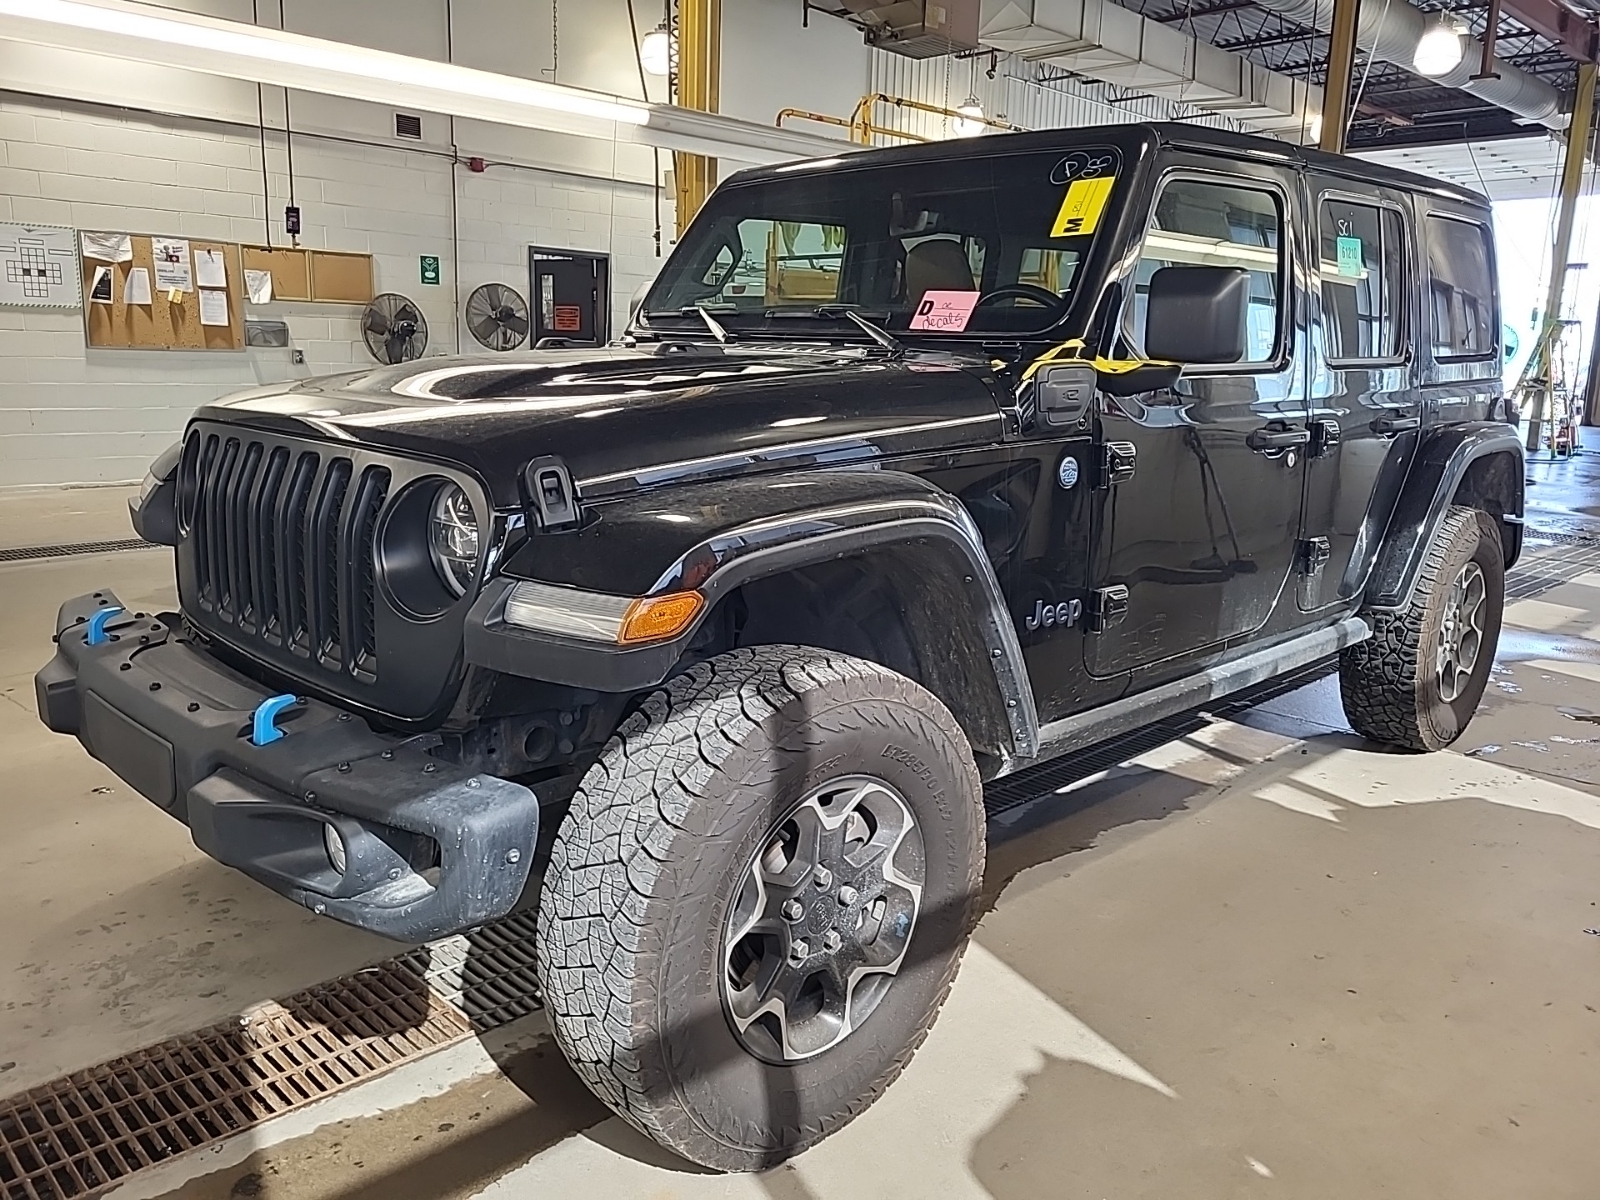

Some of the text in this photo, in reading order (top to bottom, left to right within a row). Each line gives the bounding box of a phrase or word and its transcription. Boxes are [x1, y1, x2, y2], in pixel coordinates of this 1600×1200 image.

[1063, 217, 1084, 233] M
[918, 300, 935, 316] D
[1026, 598, 1082, 631] Jeep
